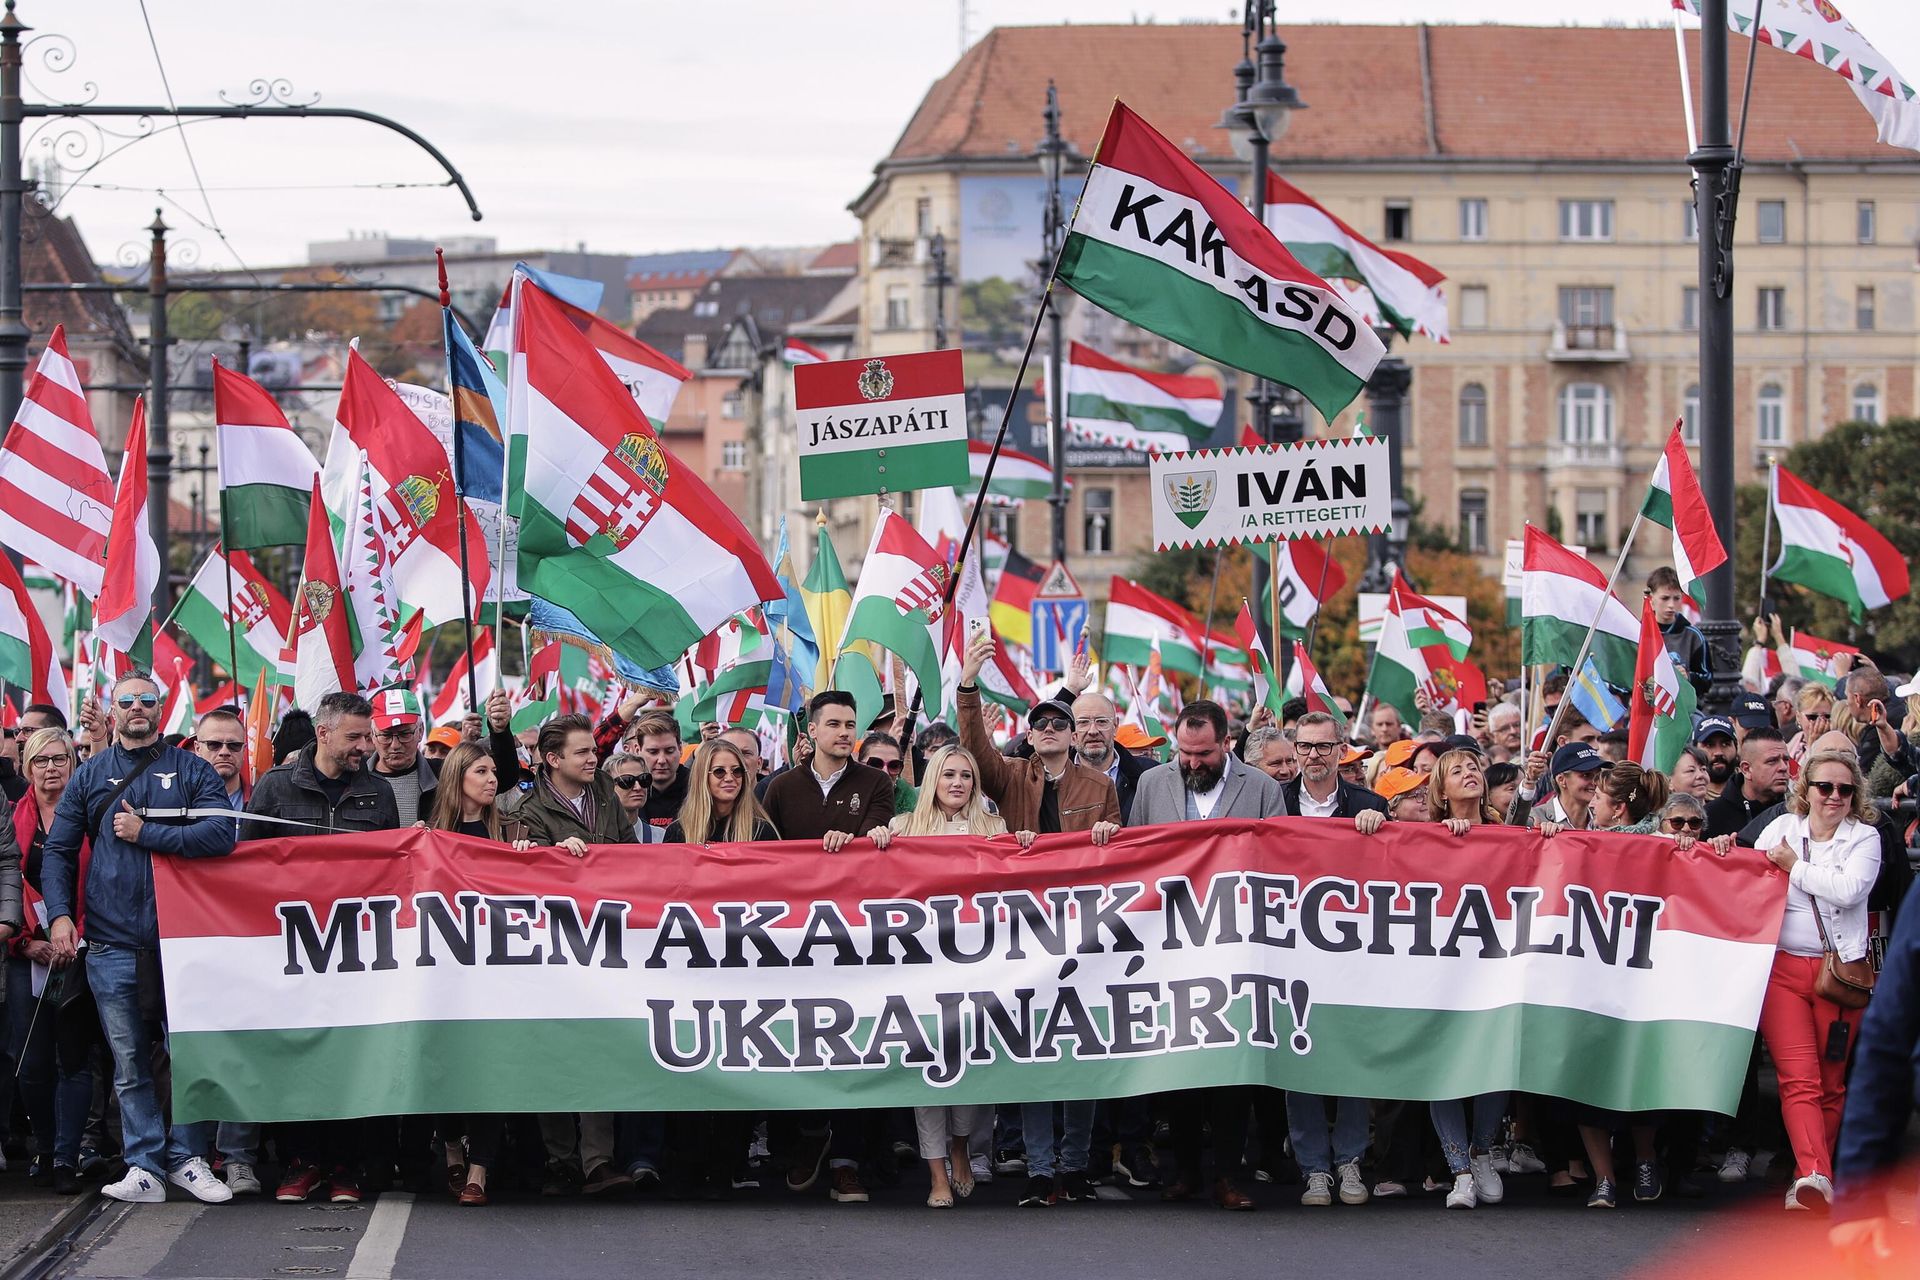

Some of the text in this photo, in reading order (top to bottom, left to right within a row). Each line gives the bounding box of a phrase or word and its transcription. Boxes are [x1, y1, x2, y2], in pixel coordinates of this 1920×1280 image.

[1110, 184, 1357, 351] KAKASD
[809, 407, 949, 447] JÁSZAPÁTI
[1237, 459, 1367, 508] IVÁN
[1263, 505, 1367, 527] RETTEGETT/
[279, 875, 1663, 975] MI NEM AKARUNK MEGHALNI
[646, 954, 1310, 1083] UKRAJNÁÉRT!
